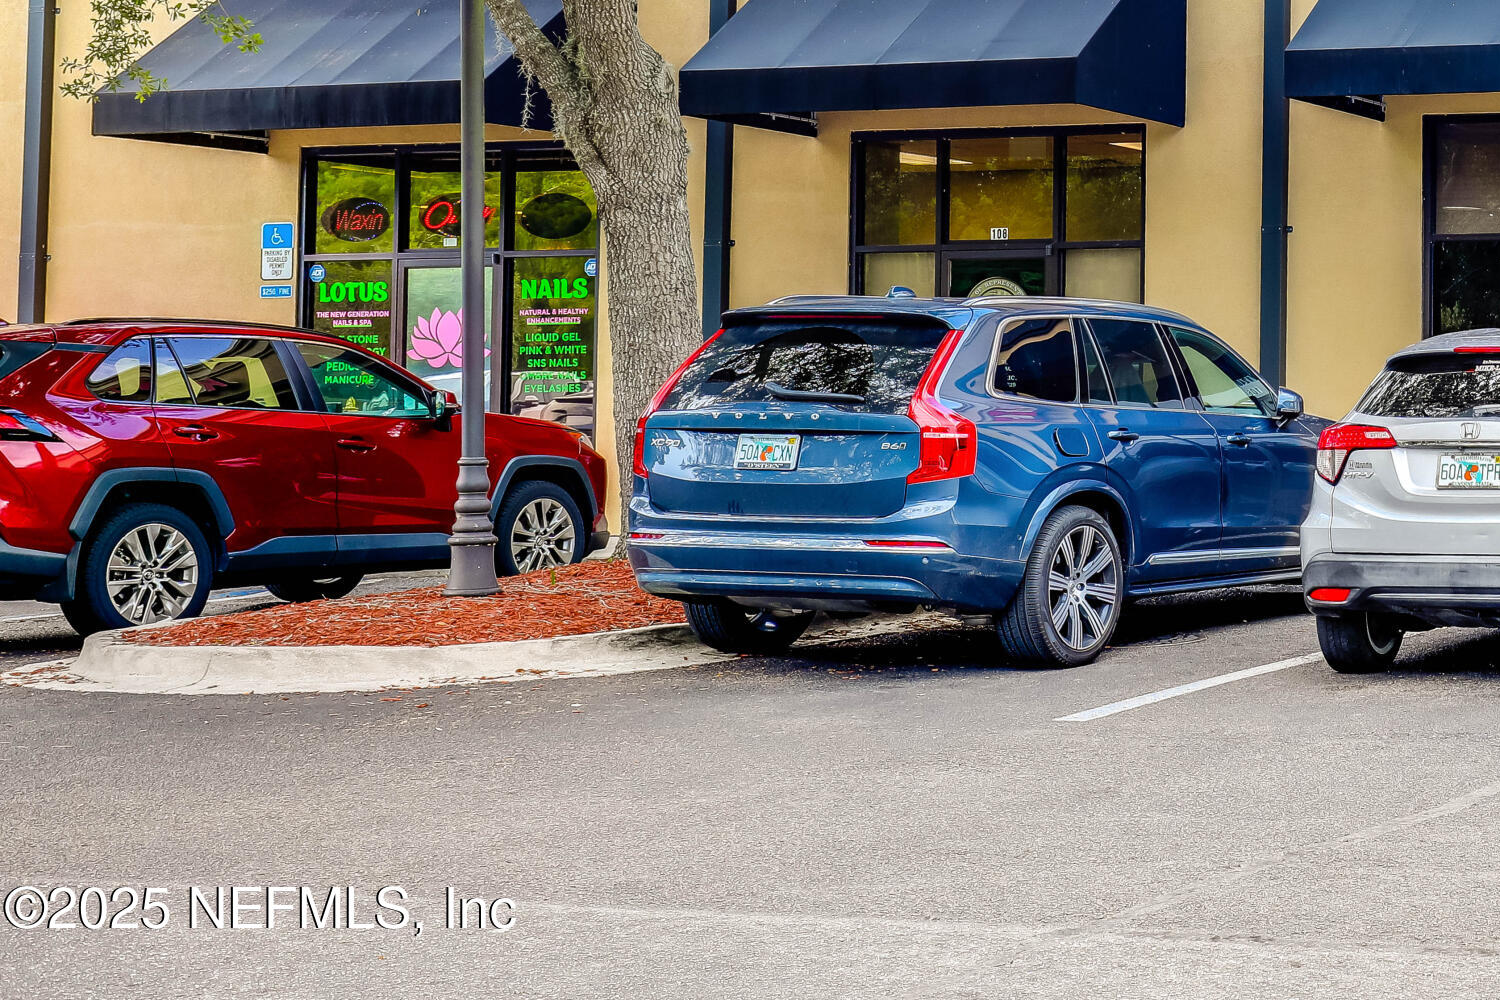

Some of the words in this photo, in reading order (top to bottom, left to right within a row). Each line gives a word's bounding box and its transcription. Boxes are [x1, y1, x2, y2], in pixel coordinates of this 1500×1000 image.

[279, 287, 290, 295] FINE
[319, 281, 388, 303] LOTUS
[521, 278, 589, 299] NAILS
[347, 310, 389, 318] GENERATION
[347, 335, 379, 343] STONE
[525, 333, 559, 342] LIQUID
[562, 332, 581, 341] GEL
[519, 346, 542, 355] PINK
[545, 346, 551, 354] &
[554, 345, 587, 354] WHITE
[527, 359, 547, 367] SNS
[549, 358, 579, 367] NAILS
[325, 375, 375, 384] MANICURE
[520, 372, 554, 380] OMBRE
[557, 371, 587, 380] NAILS
[524, 383, 582, 393] EYELASHES
[711, 412, 820, 421] VOLVO
